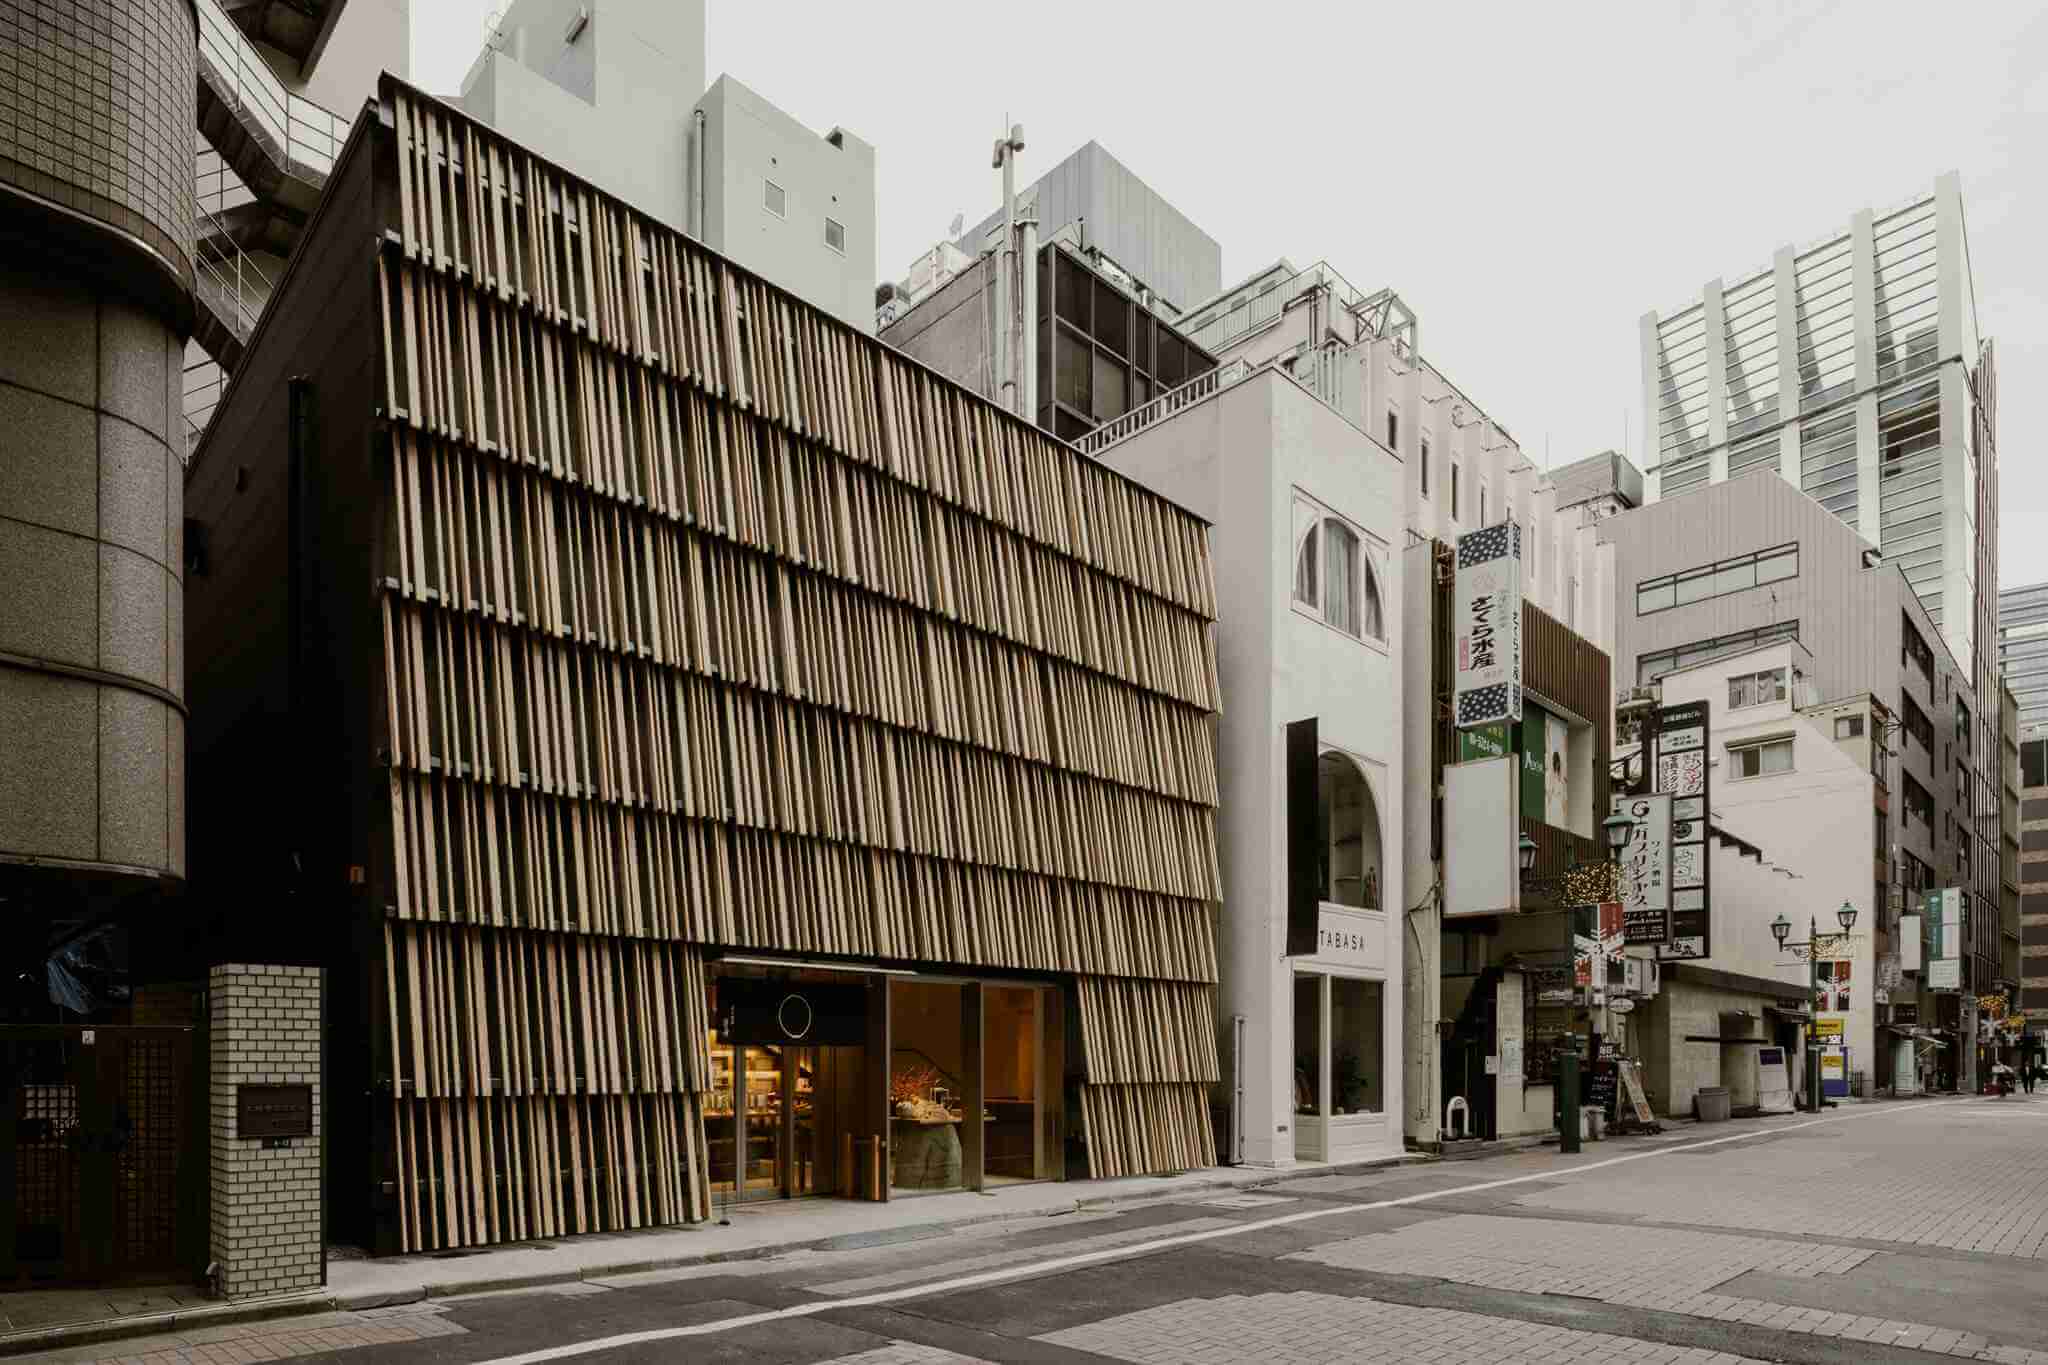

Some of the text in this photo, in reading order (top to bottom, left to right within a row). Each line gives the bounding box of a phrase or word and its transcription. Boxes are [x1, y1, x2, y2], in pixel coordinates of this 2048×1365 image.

[1470, 595, 1495, 671] さくら水産
[1320, 930, 1365, 950] TABASA
